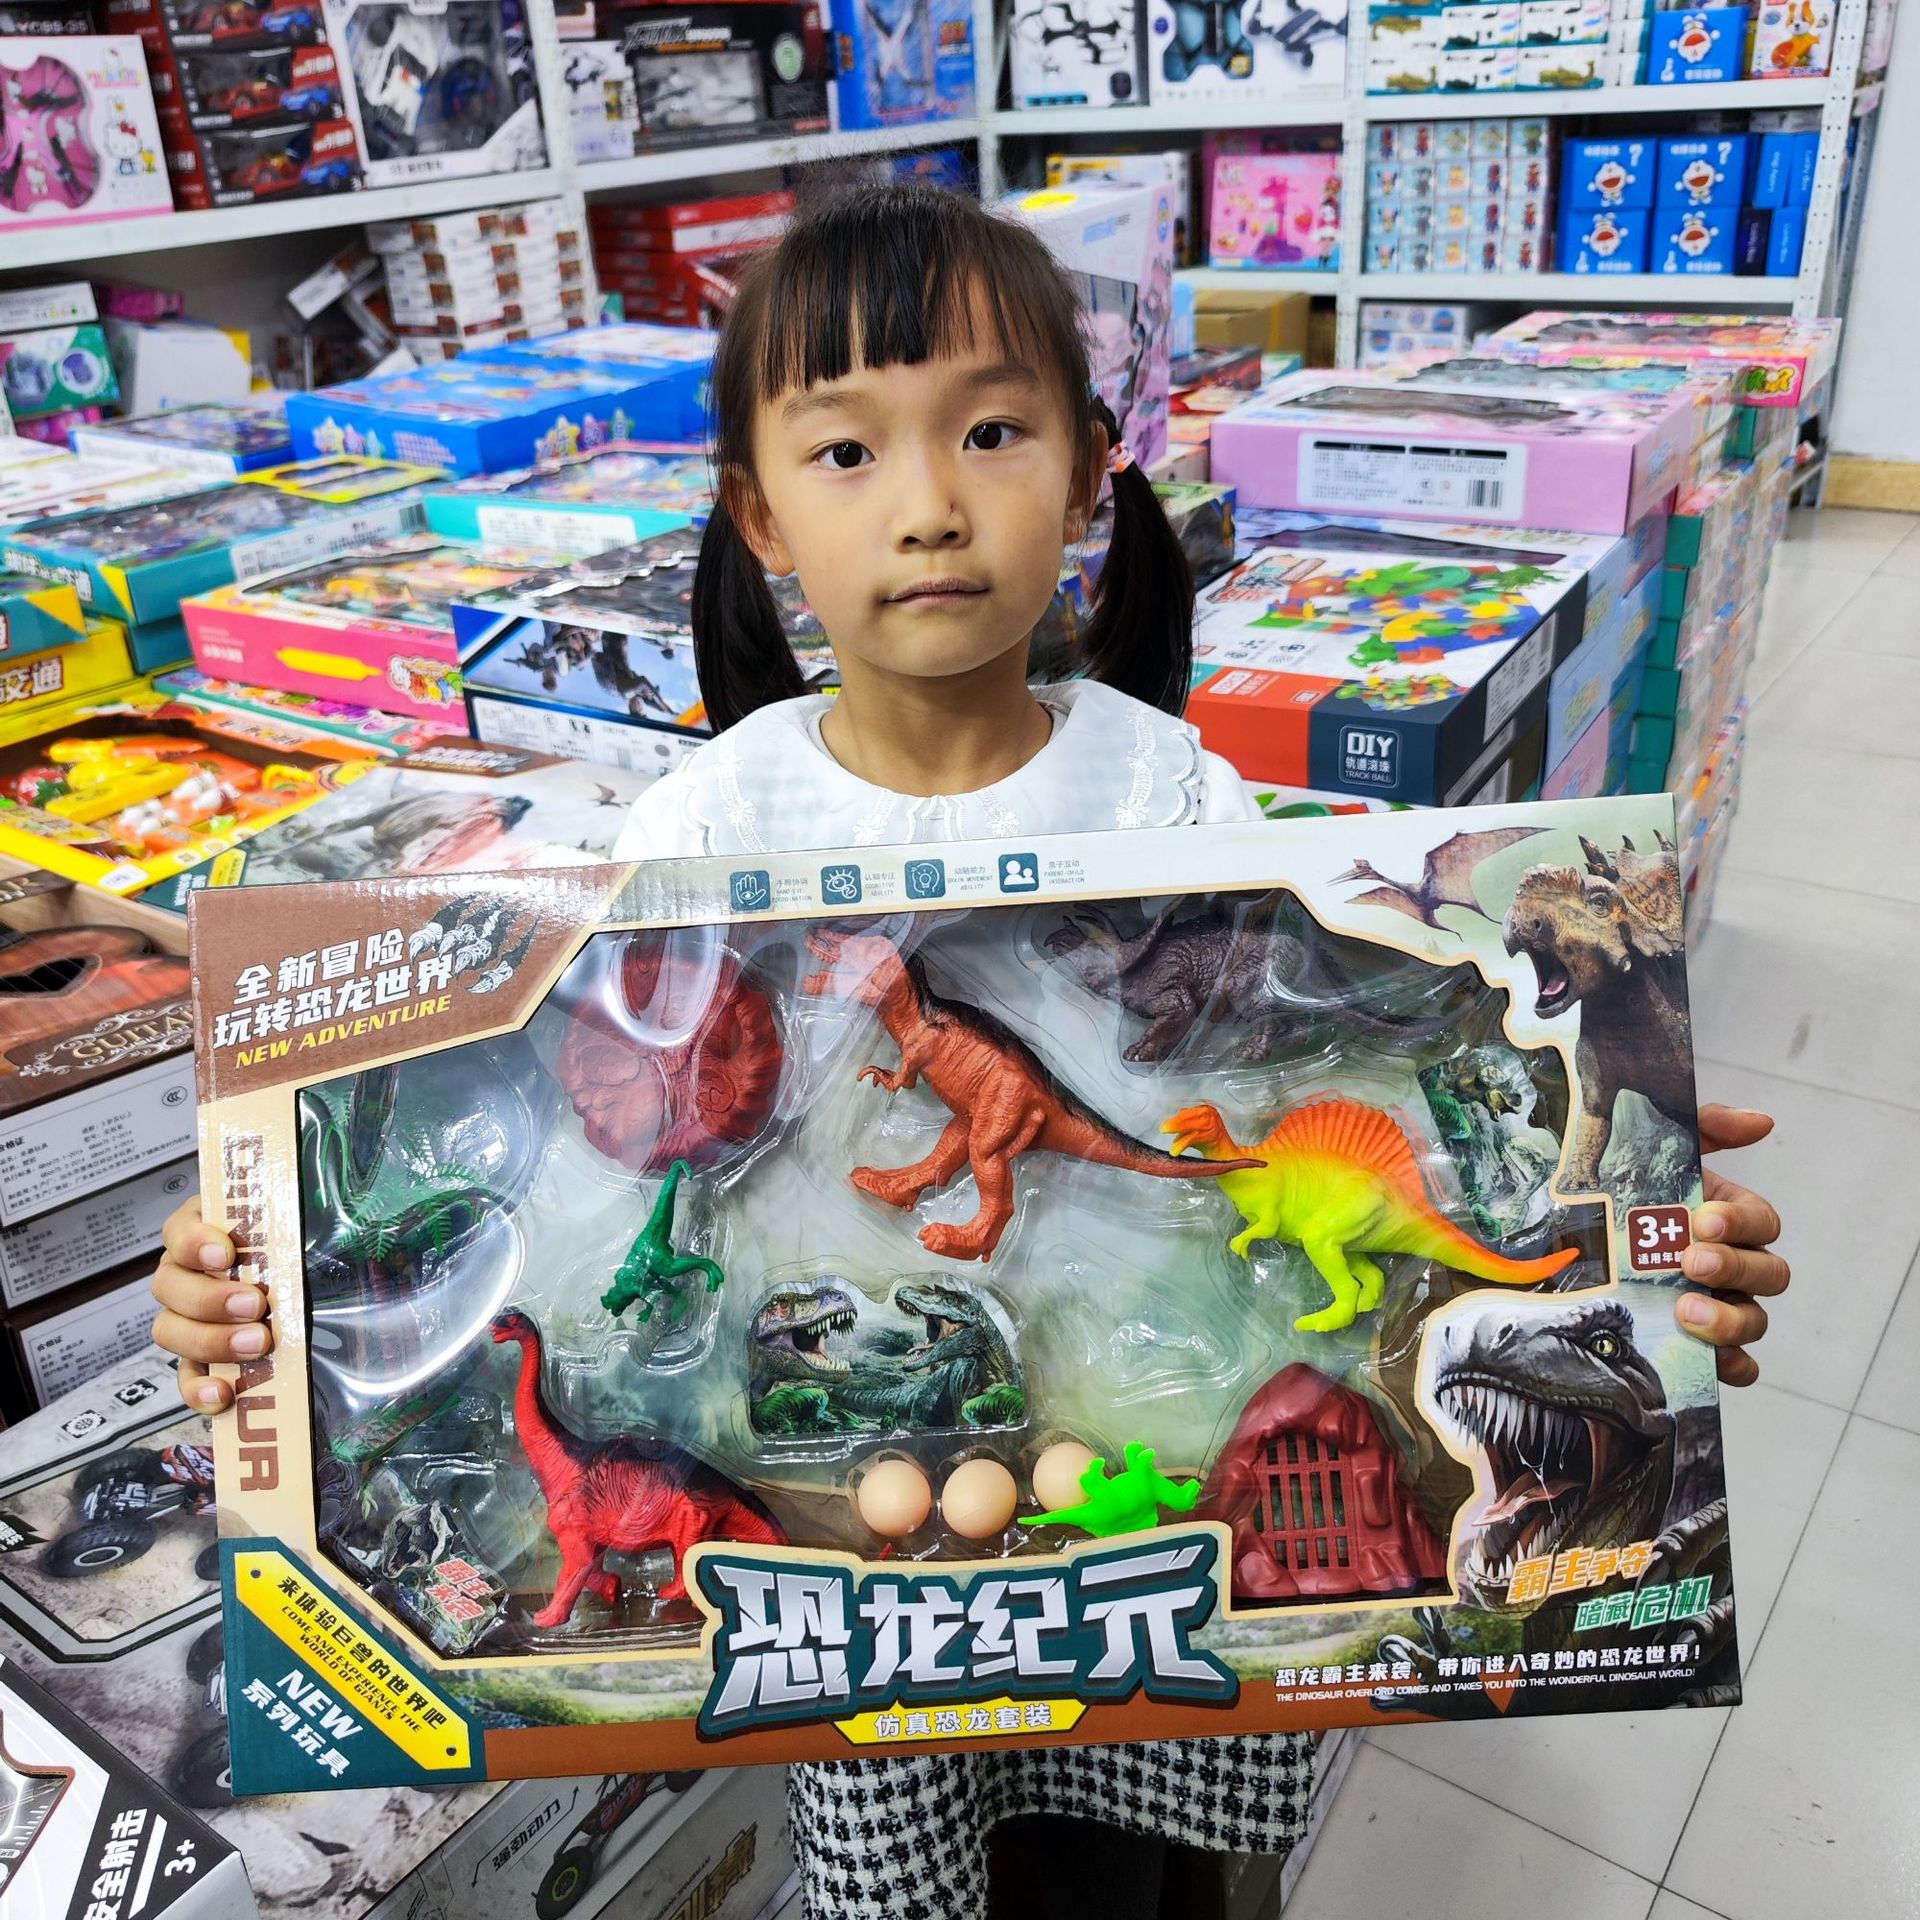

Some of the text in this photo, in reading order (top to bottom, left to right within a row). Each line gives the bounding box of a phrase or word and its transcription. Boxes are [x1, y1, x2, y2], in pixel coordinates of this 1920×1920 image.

[1344, 756, 1390, 773] 轨道滚珠
[1345, 770, 1392, 783] TRACK BALL
[1347, 732, 1393, 758] DIY
[213, 954, 454, 1049] 玩转恐龙世界
[234, 927, 405, 1005] 全新冒险
[235, 1037, 293, 1068] NEW
[298, 994, 451, 1051] ADVENTURE
[1636, 1215, 1684, 1248] 3+
[1506, 1539, 1654, 1604] 霸主争夺
[1573, 1574, 1714, 1633] 暗藏危机
[277, 1576, 448, 1730] 来体验巨兽的世界吧
[712, 1544, 1226, 1717] 恐龙纪元
[276, 1668, 364, 1741] NEW
[281, 1605, 423, 1732] COME AND EXPERIENCE THE
[299, 1633, 393, 1720] WORLD OF GIANTS
[1276, 1667, 1696, 1702] THE DINOSAUR OVERLORD COMES AND TAKES YOU INTO THE WONDERFUL DINOSAUR WORLD!
[241, 1678, 350, 1779] 系列玩具
[874, 1703, 1053, 1737] 仿真恐龙套装
[164, 1838, 198, 1878] 3+
[491, 1798, 561, 1873] 强劲动力
